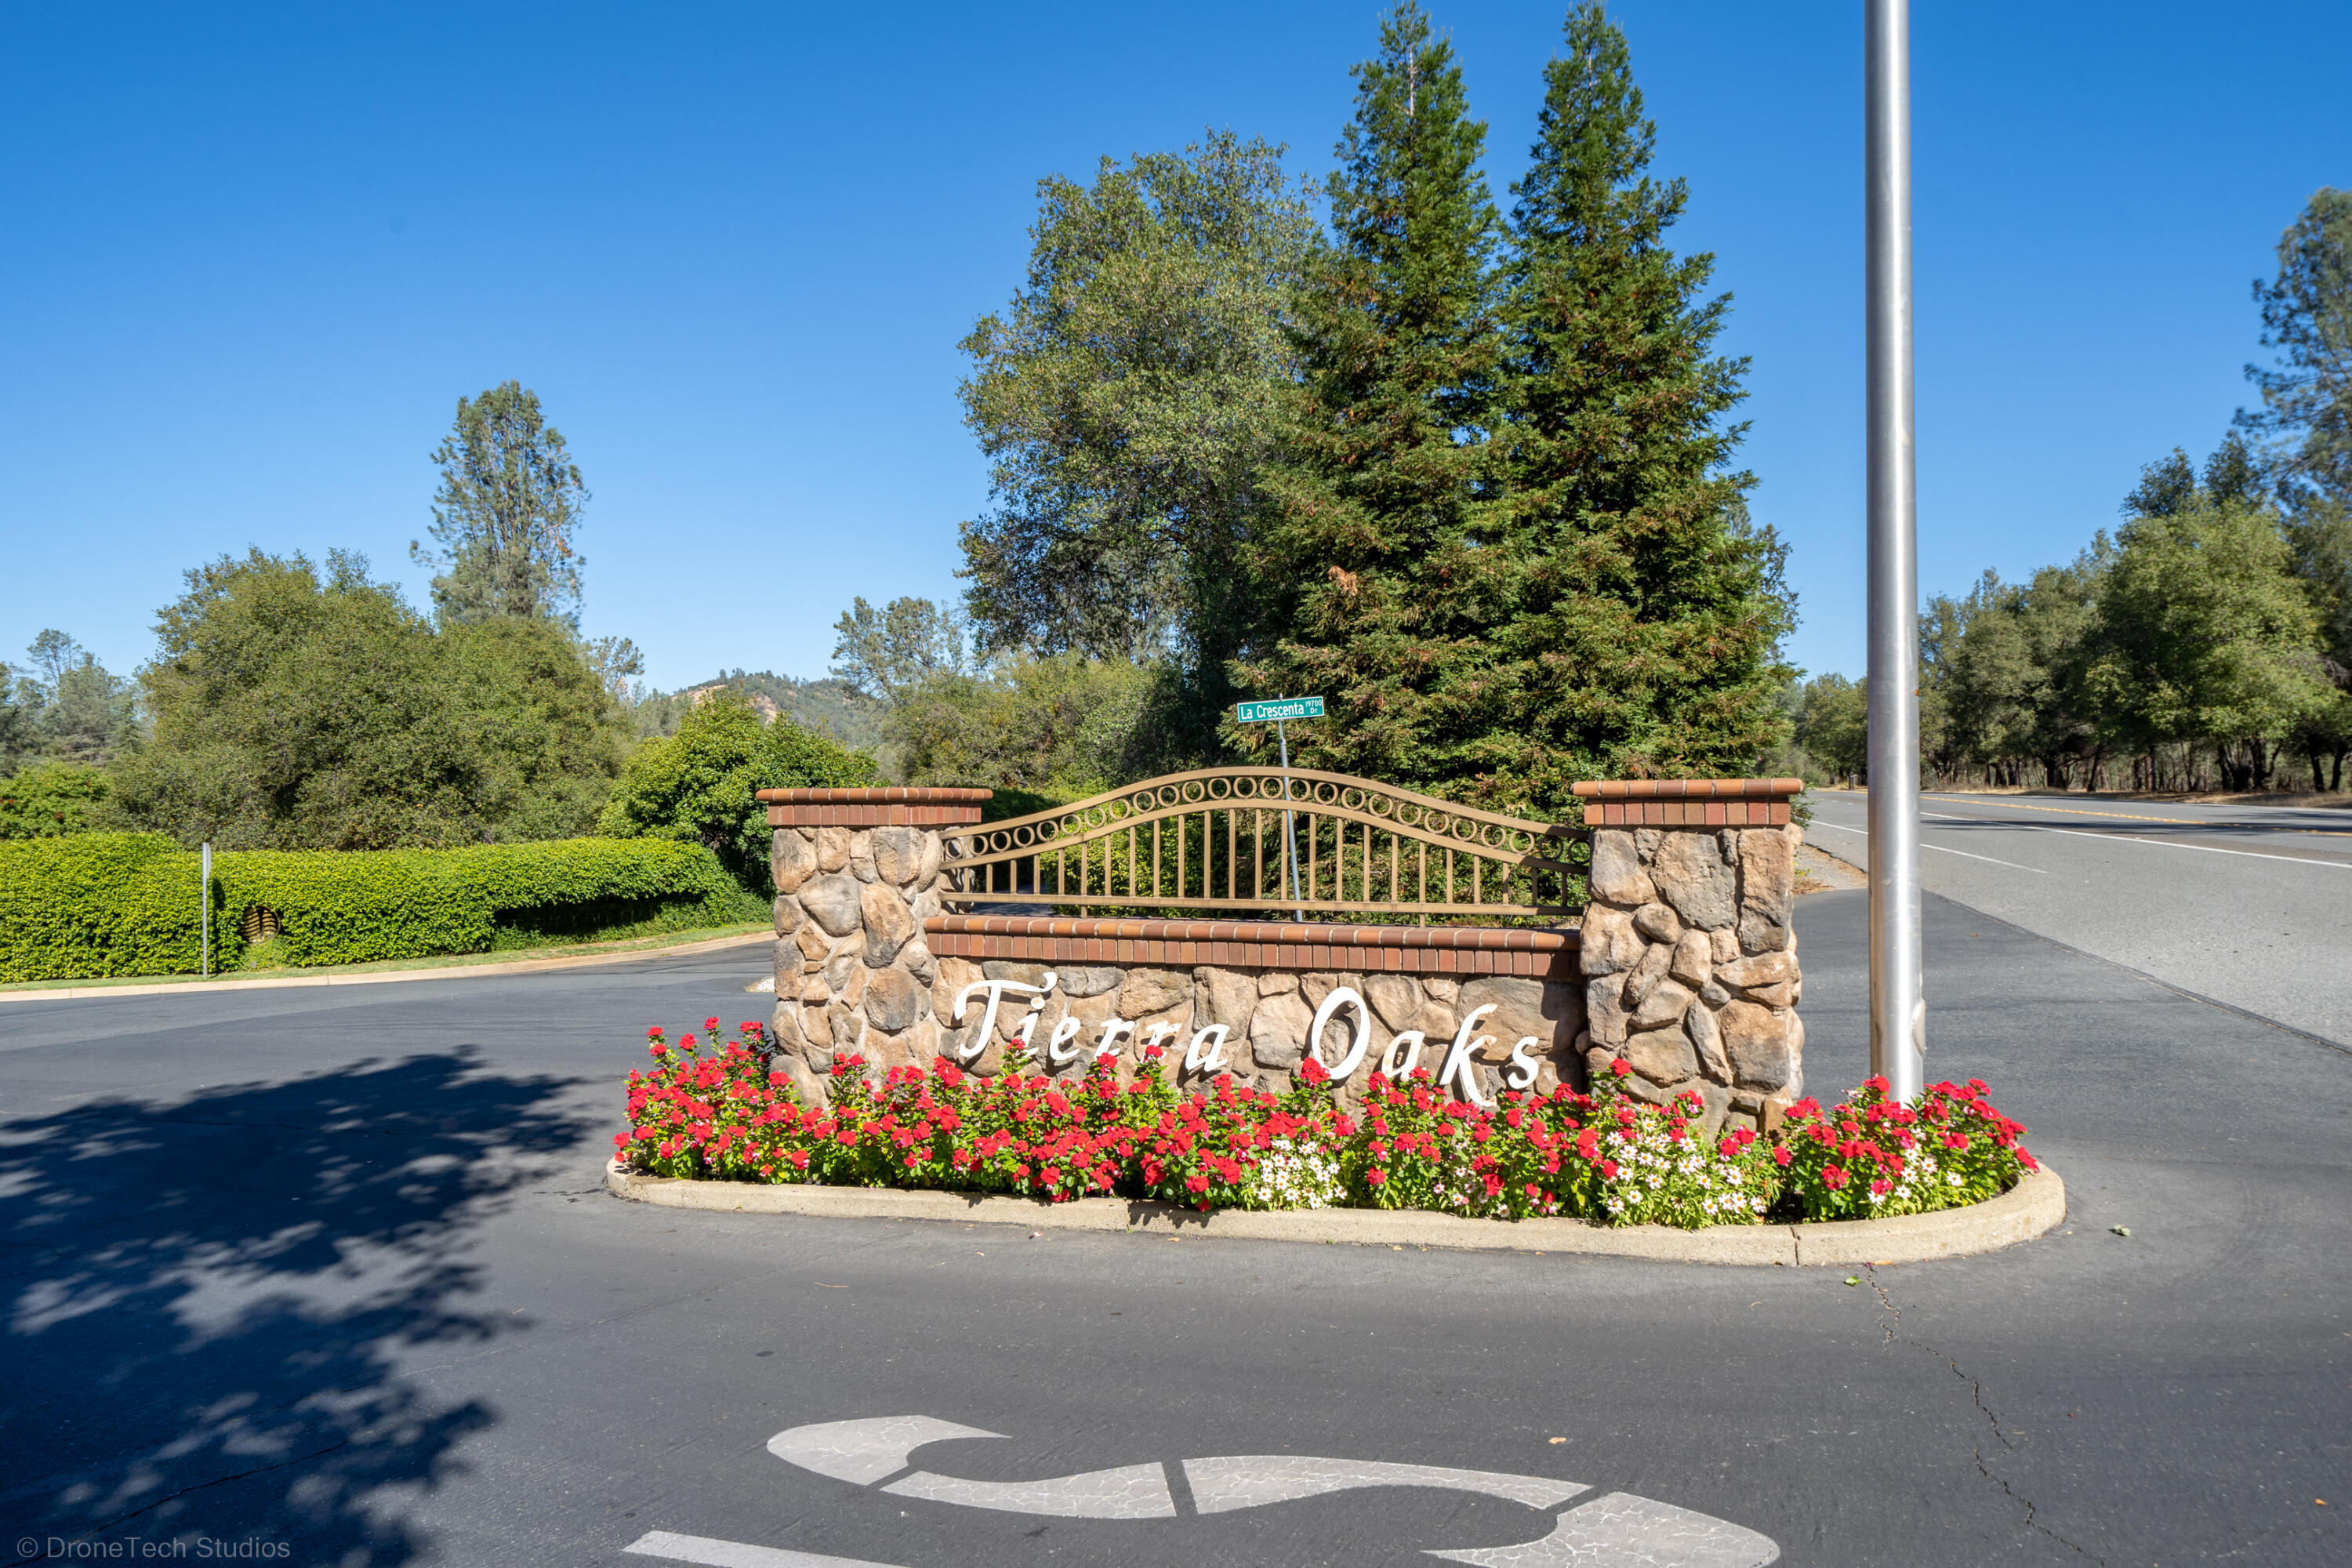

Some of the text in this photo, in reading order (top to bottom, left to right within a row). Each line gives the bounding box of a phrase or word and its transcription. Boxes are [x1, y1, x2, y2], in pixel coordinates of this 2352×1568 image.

[1240, 702, 1305, 720] La Crescenta
[953, 971, 1539, 1107] Tierra Oaks
